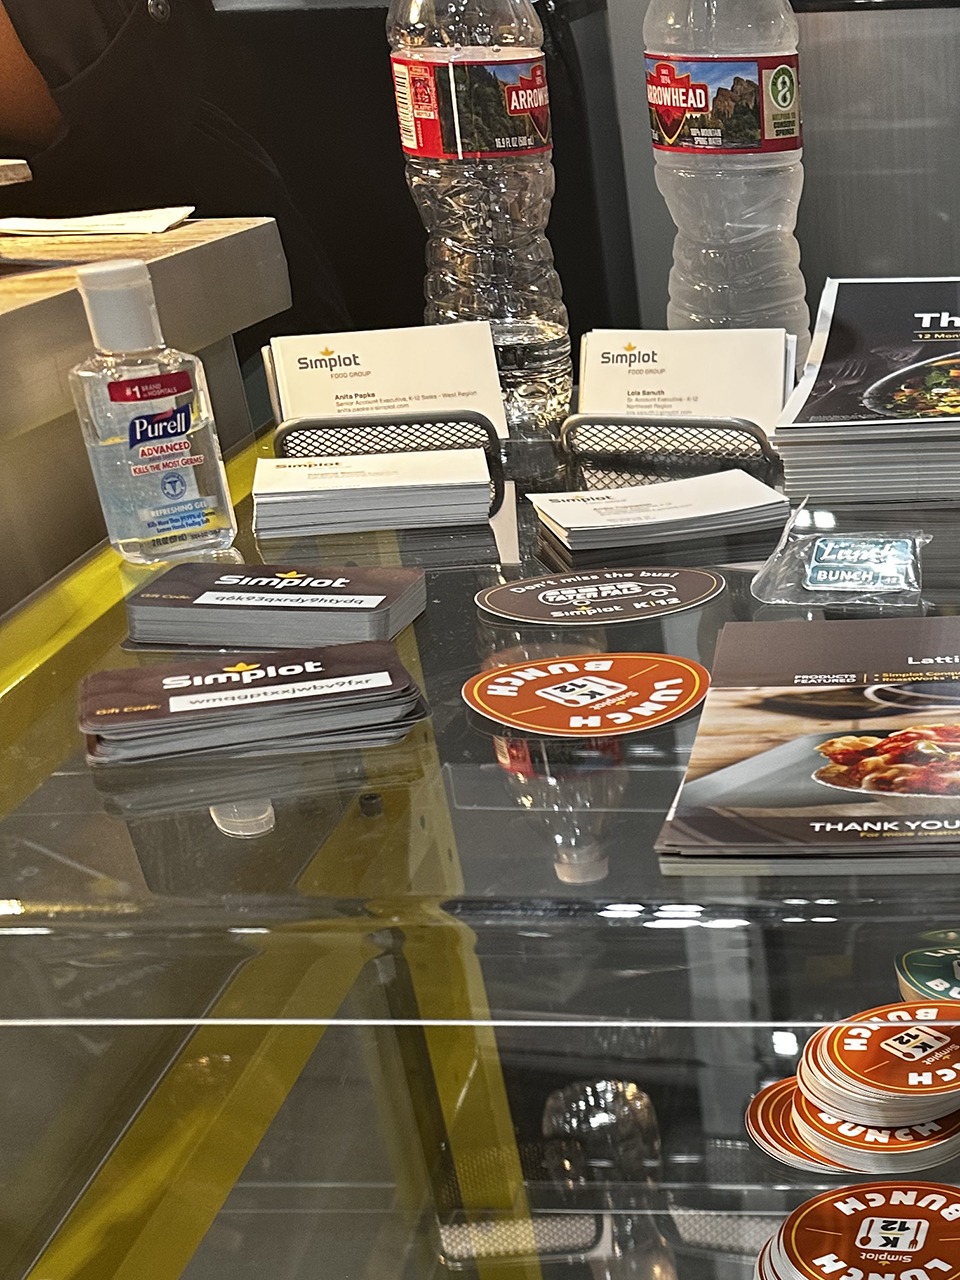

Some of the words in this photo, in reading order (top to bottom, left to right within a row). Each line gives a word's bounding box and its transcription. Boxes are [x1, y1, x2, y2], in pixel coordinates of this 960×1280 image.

[298, 353, 360, 372] Simplot
[600, 351, 658, 367] Simplot
[125, 386, 141, 399] #1
[354, 392, 375, 400] Papke
[135, 412, 185, 440] Purell
[140, 441, 190, 457] ADVANCED
[151, 503, 193, 518] REFRESHING
[215, 574, 350, 589] Simplot
[509, 579, 557, 594] Don't
[561, 574, 599, 585] miss
[639, 570, 680, 578] bus!
[817, 570, 874, 582] BUNCH
[545, 590, 599, 601] TATER
[600, 586, 643, 599] PALS
[550, 605, 624, 618] Simplot
[162, 660, 323, 690] Simplot
[486, 660, 614, 697] BUNCH
[569, 678, 683, 728] LUNCH
[577, 691, 604, 700] K
[588, 691, 640, 711] Simplot
[809, 820, 900, 833] THANK
[843, 1008, 939, 1052] BUNCH
[911, 1040, 936, 1053] K
[877, 1235, 901, 1248] K
[858, 1251, 913, 1264] Simplot
